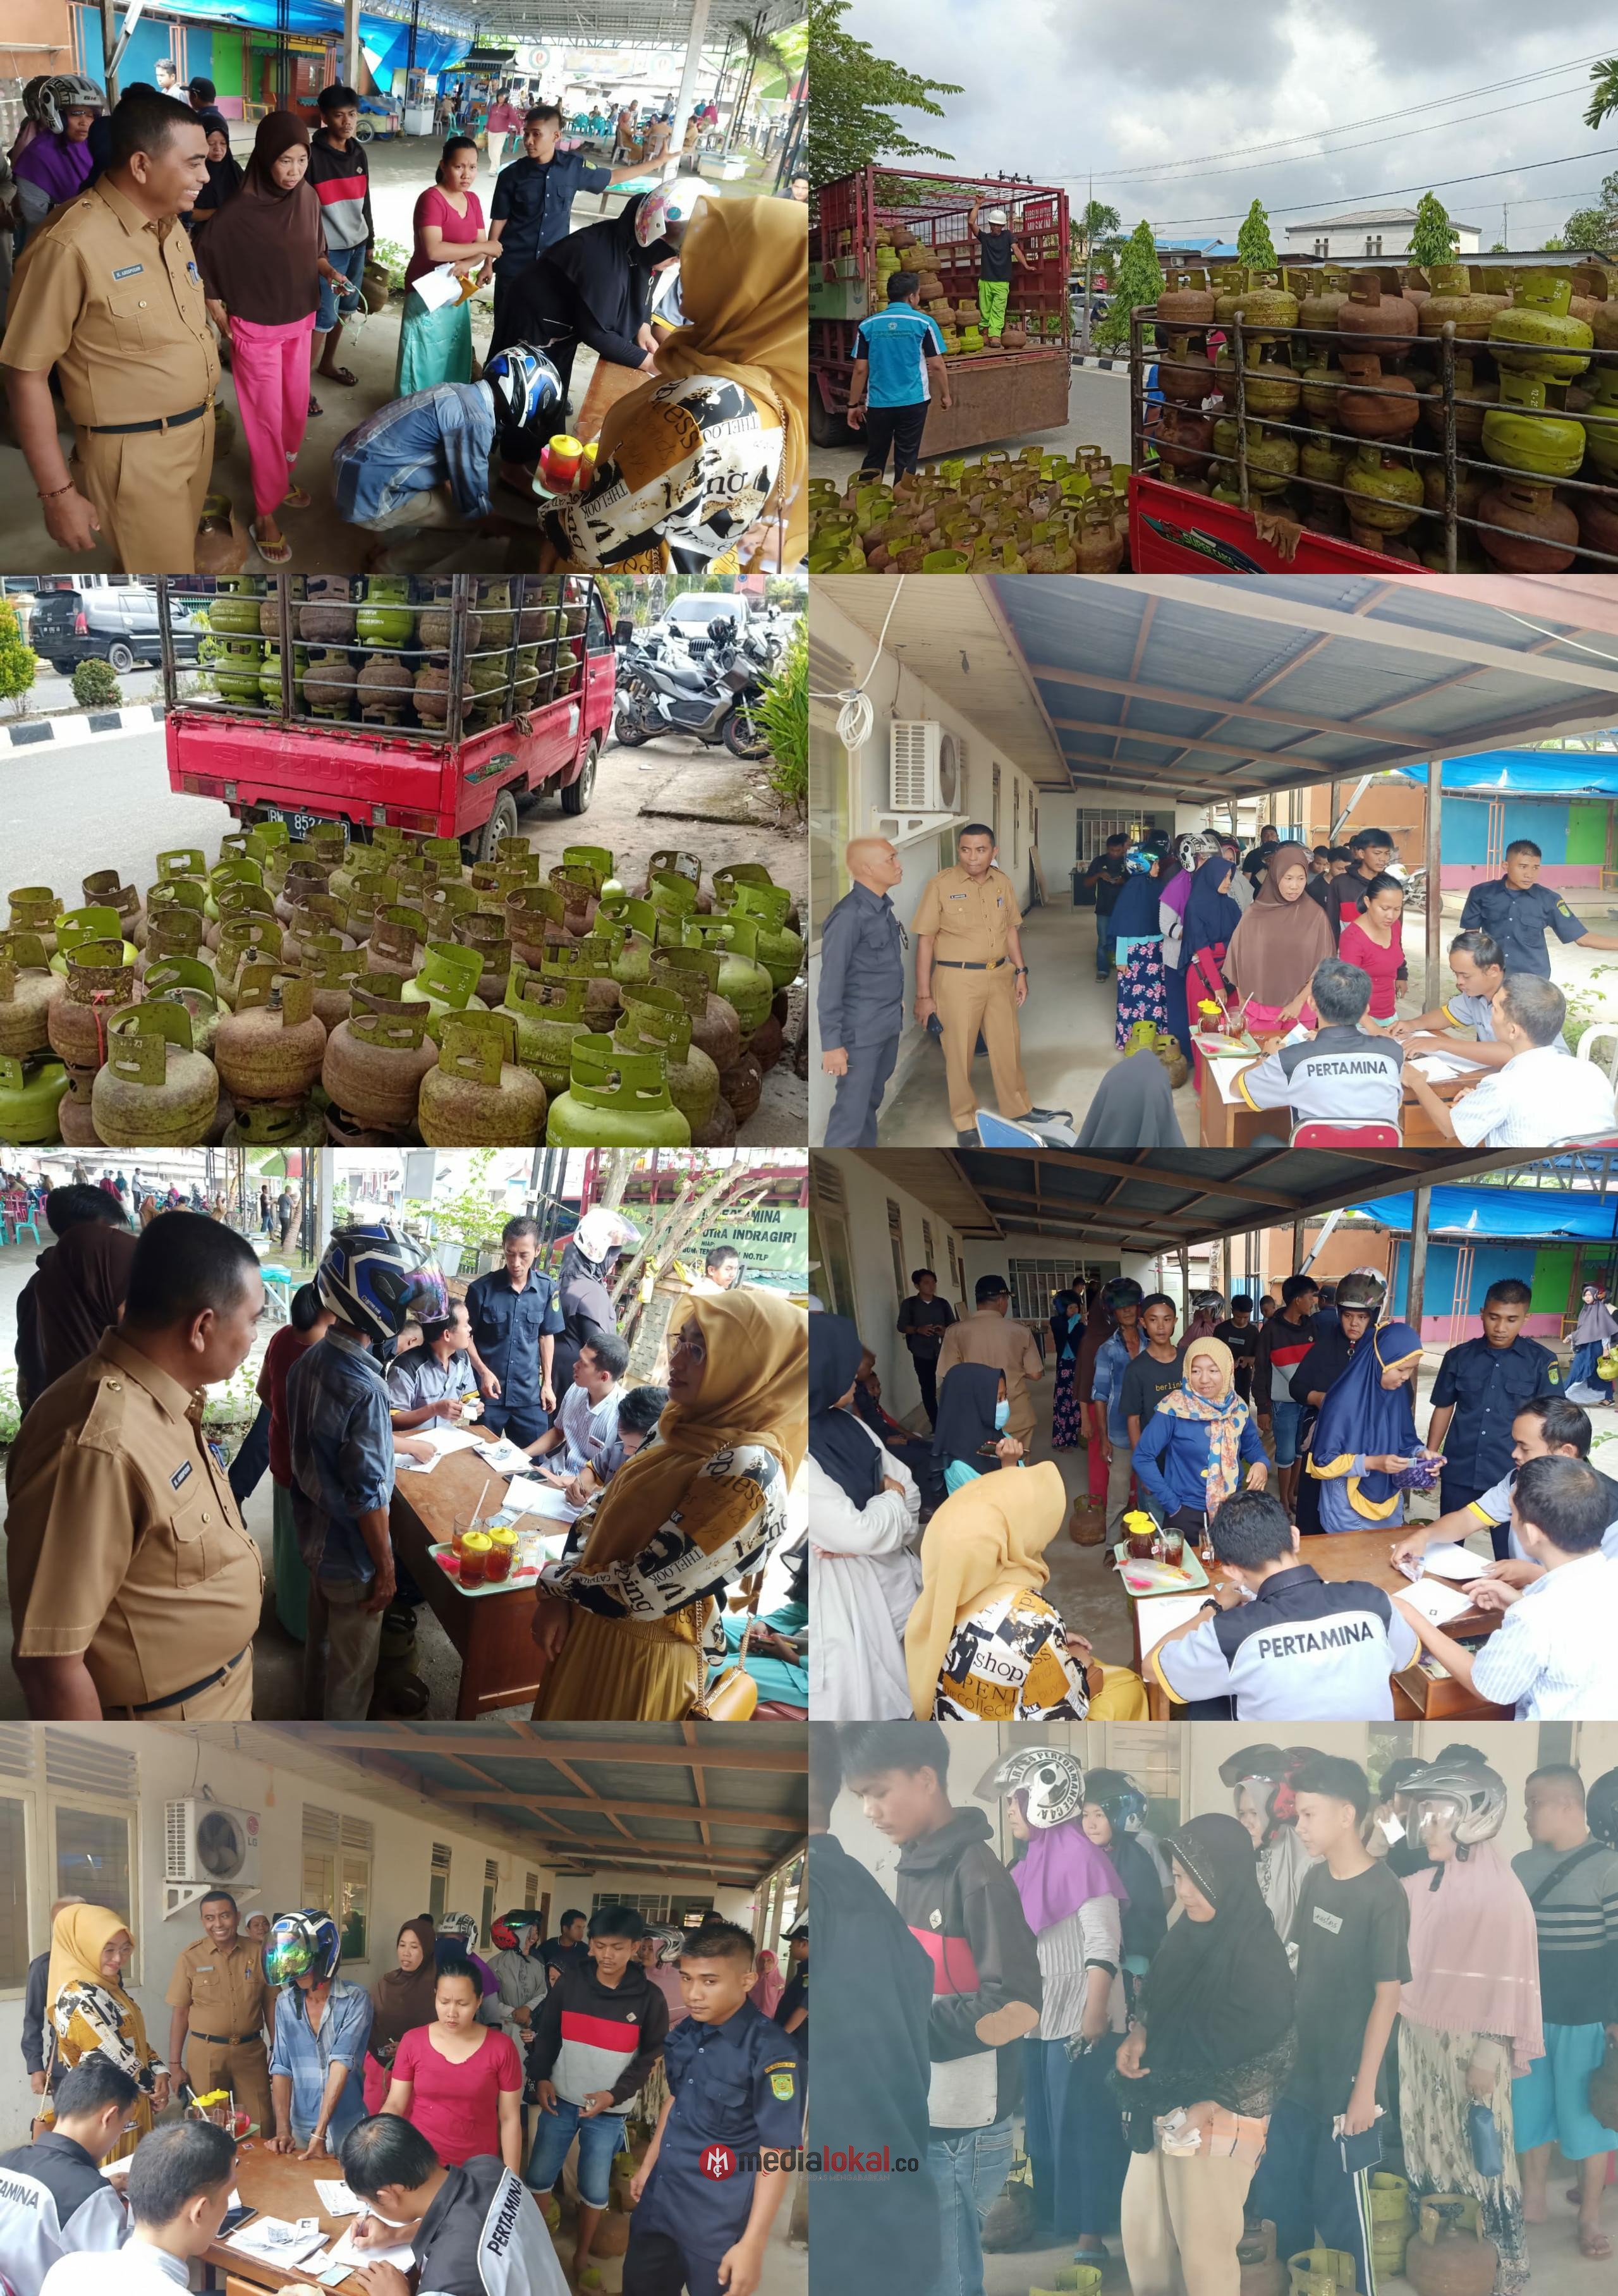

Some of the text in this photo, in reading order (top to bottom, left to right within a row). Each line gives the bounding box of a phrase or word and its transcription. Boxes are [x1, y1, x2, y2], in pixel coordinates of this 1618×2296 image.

[581, 482, 628, 520] THELOOK
[212, 744, 396, 788] SUZUKI
[1306, 1061, 1388, 1077] PERTAMINA
[701, 1228, 798, 1244] UTRA INDRAGIRI
[649, 1549, 704, 1585] THELOOK
[1258, 1621, 1375, 1659] PERTAMINA
[1037, 1752, 1079, 1811] PERFORMANCE
[248, 1836, 258, 1847] LG
[486, 2177, 523, 2257] PERTAMINA
